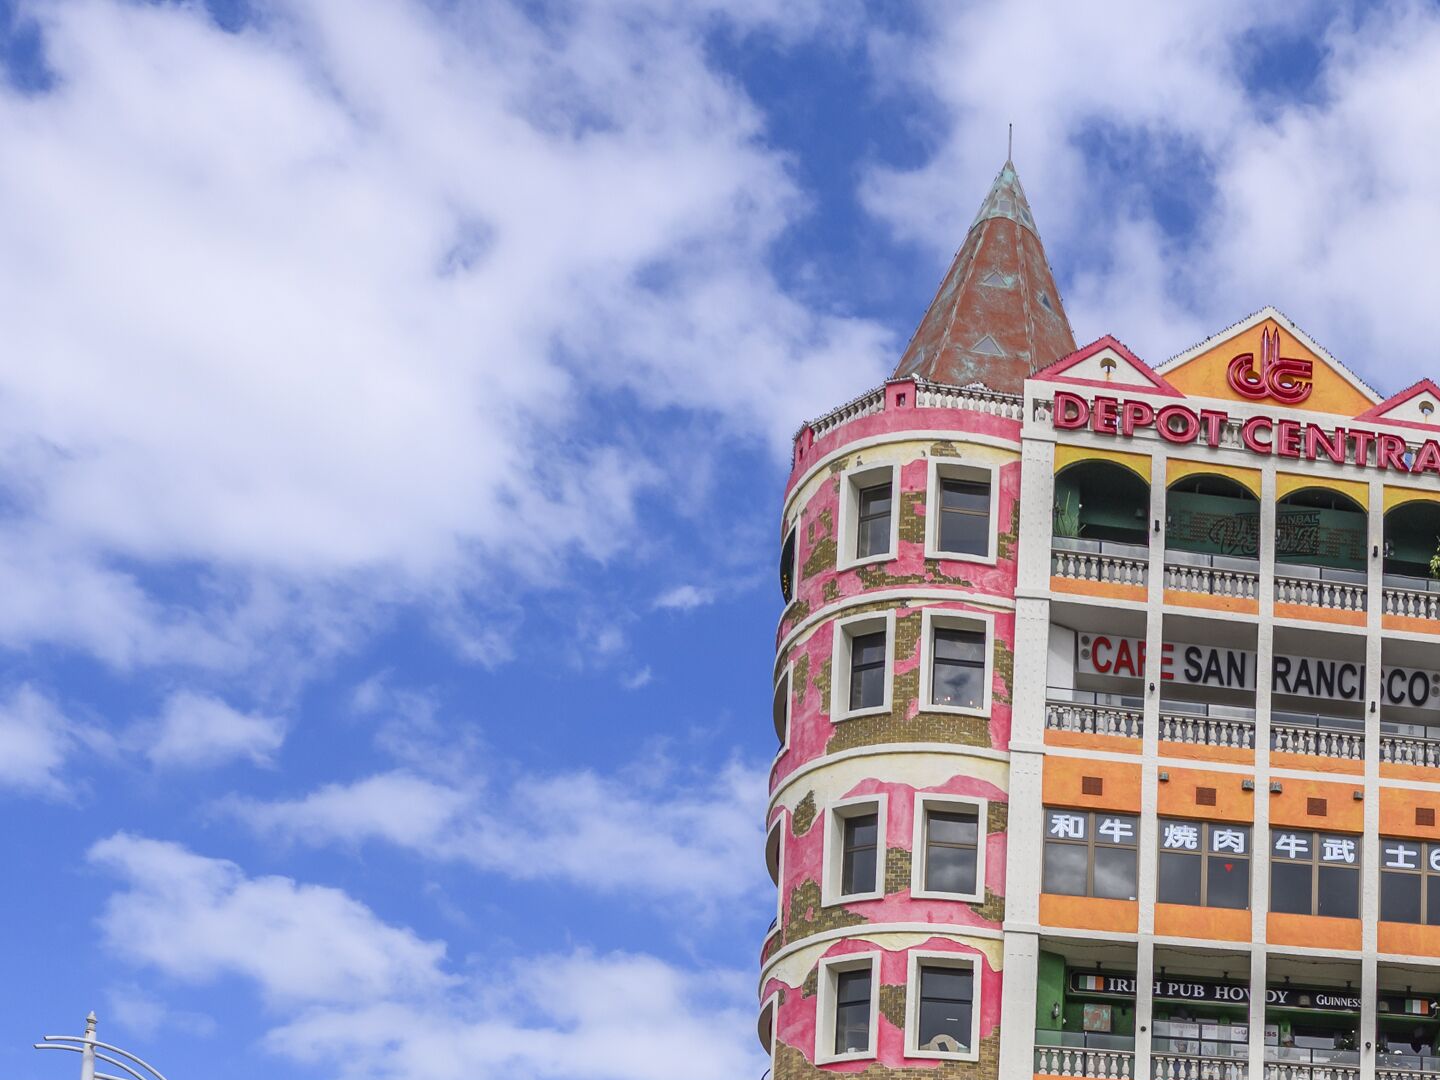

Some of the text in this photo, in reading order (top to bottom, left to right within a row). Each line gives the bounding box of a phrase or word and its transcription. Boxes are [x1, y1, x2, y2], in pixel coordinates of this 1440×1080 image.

[1053, 391, 1228, 449] DEPOT
[1184, 646, 1245, 687] SAN
[1255, 653, 1430, 706] RANCICO
[1108, 977, 1162, 995] IRIH
[1168, 979, 1205, 997] PUB
